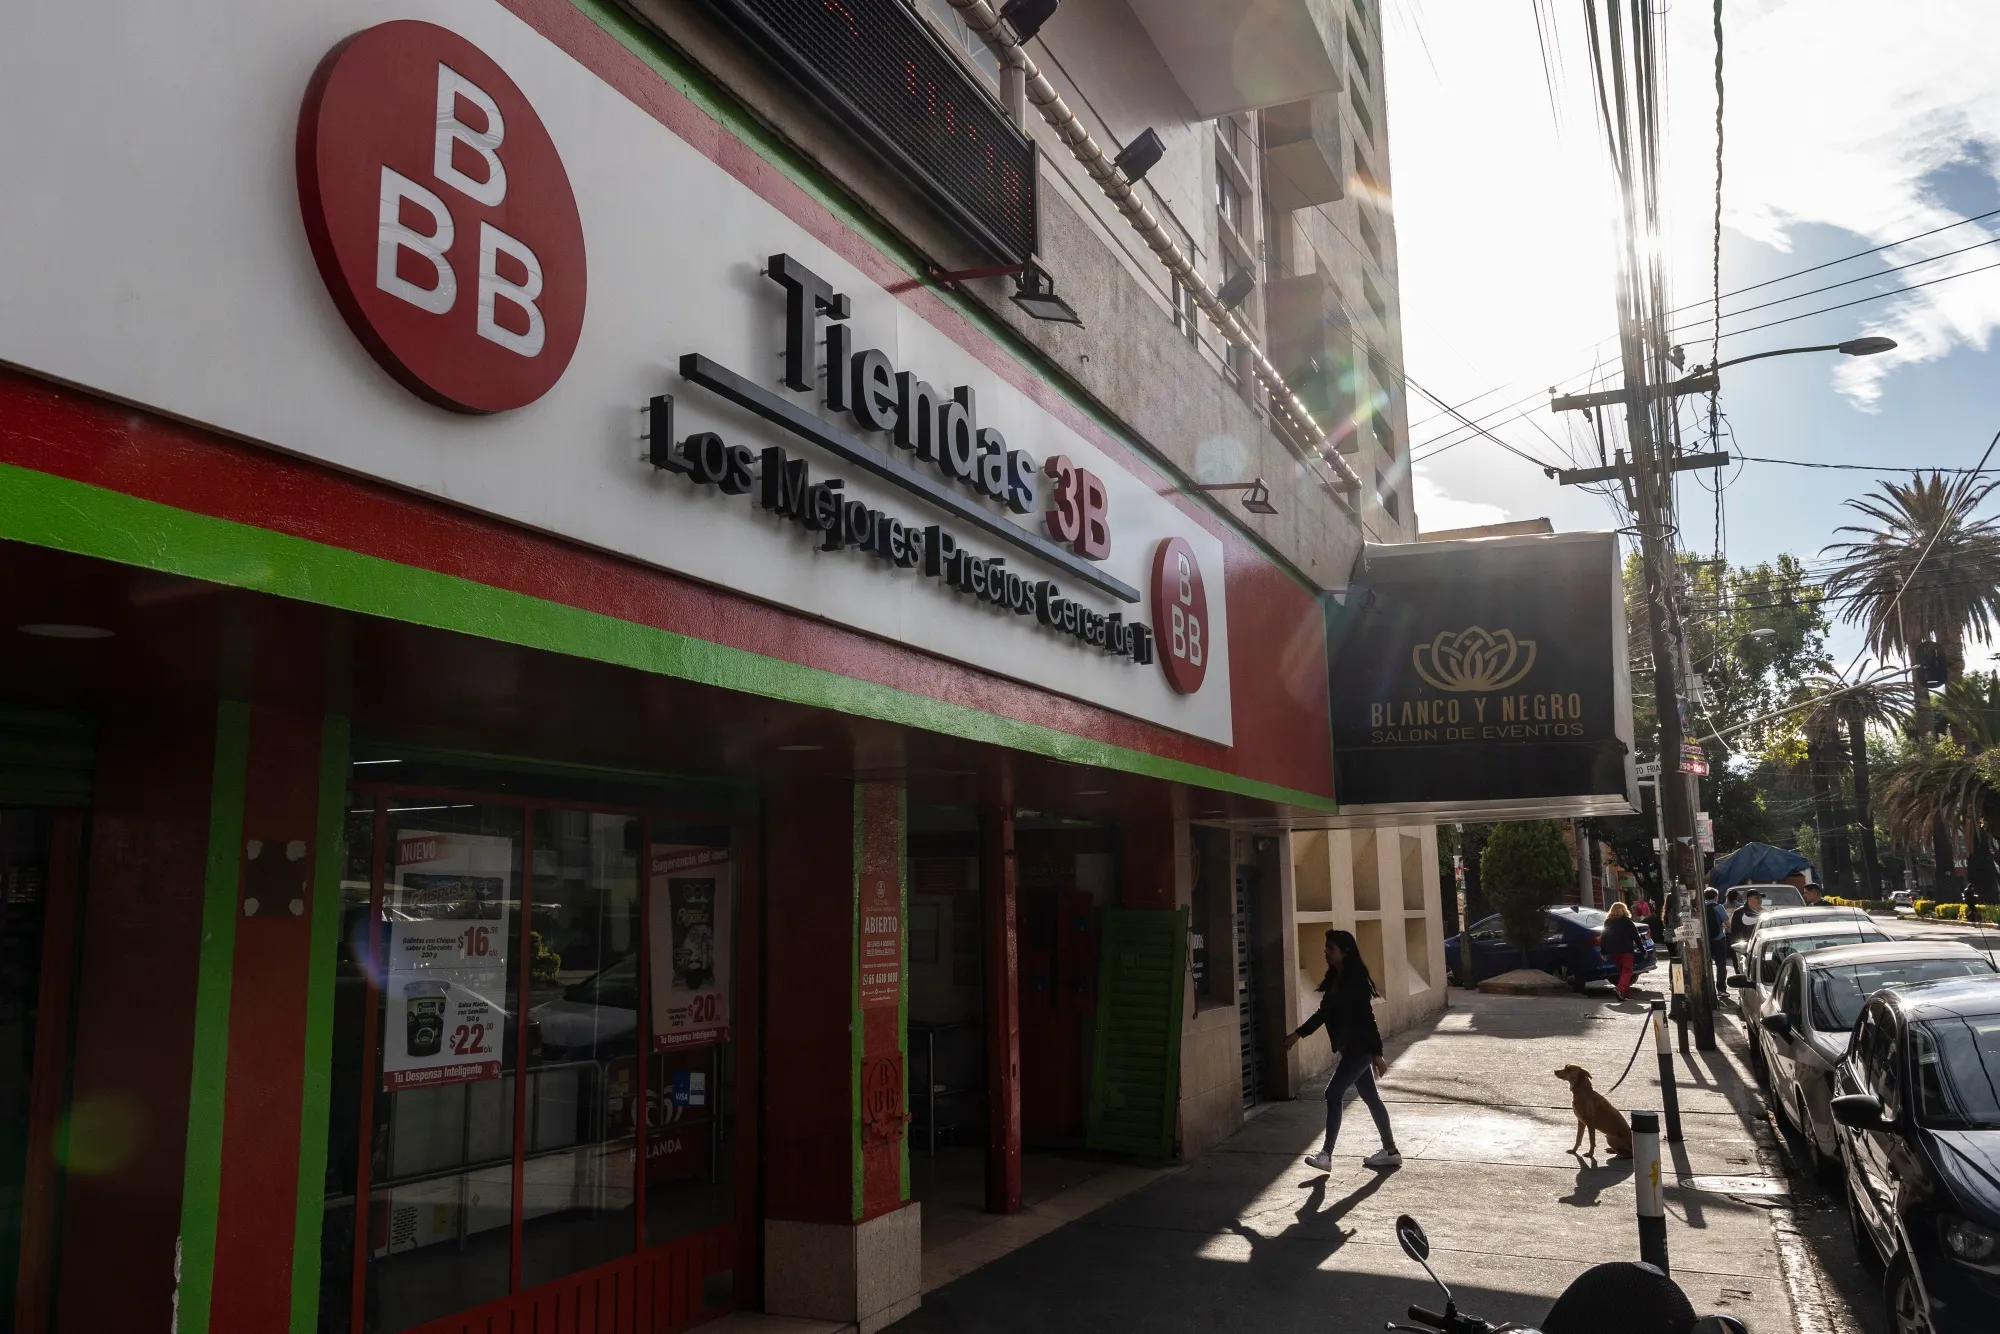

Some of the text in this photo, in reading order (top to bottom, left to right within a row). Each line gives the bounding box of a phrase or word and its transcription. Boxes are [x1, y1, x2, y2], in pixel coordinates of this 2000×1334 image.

[434, 60, 508, 206] B
[768, 253, 1111, 560] Tiendas 3B
[650, 395, 1153, 664] Los Mejores Precios Cerca de Ti
[1178, 551, 1192, 606] B
[1371, 693, 1582, 727] BLANCO Y NEGRO
[1372, 723, 1584, 743] SALON DE EVENTOS
[401, 841, 436, 862] NUEVO
[651, 849, 728, 873] Sugerencia del mes
[865, 916, 898, 933] ABIERTO
[667, 1034, 691, 1044] Despensa
[692, 1029, 717, 1040] Inteligente
[394, 1072, 403, 1083] Tu
[405, 1069, 442, 1082] Despensa
[444, 1064, 482, 1077] Inteligente
[676, 1092, 688, 1100] VISA
[629, 1136, 682, 1164] HLANDA
